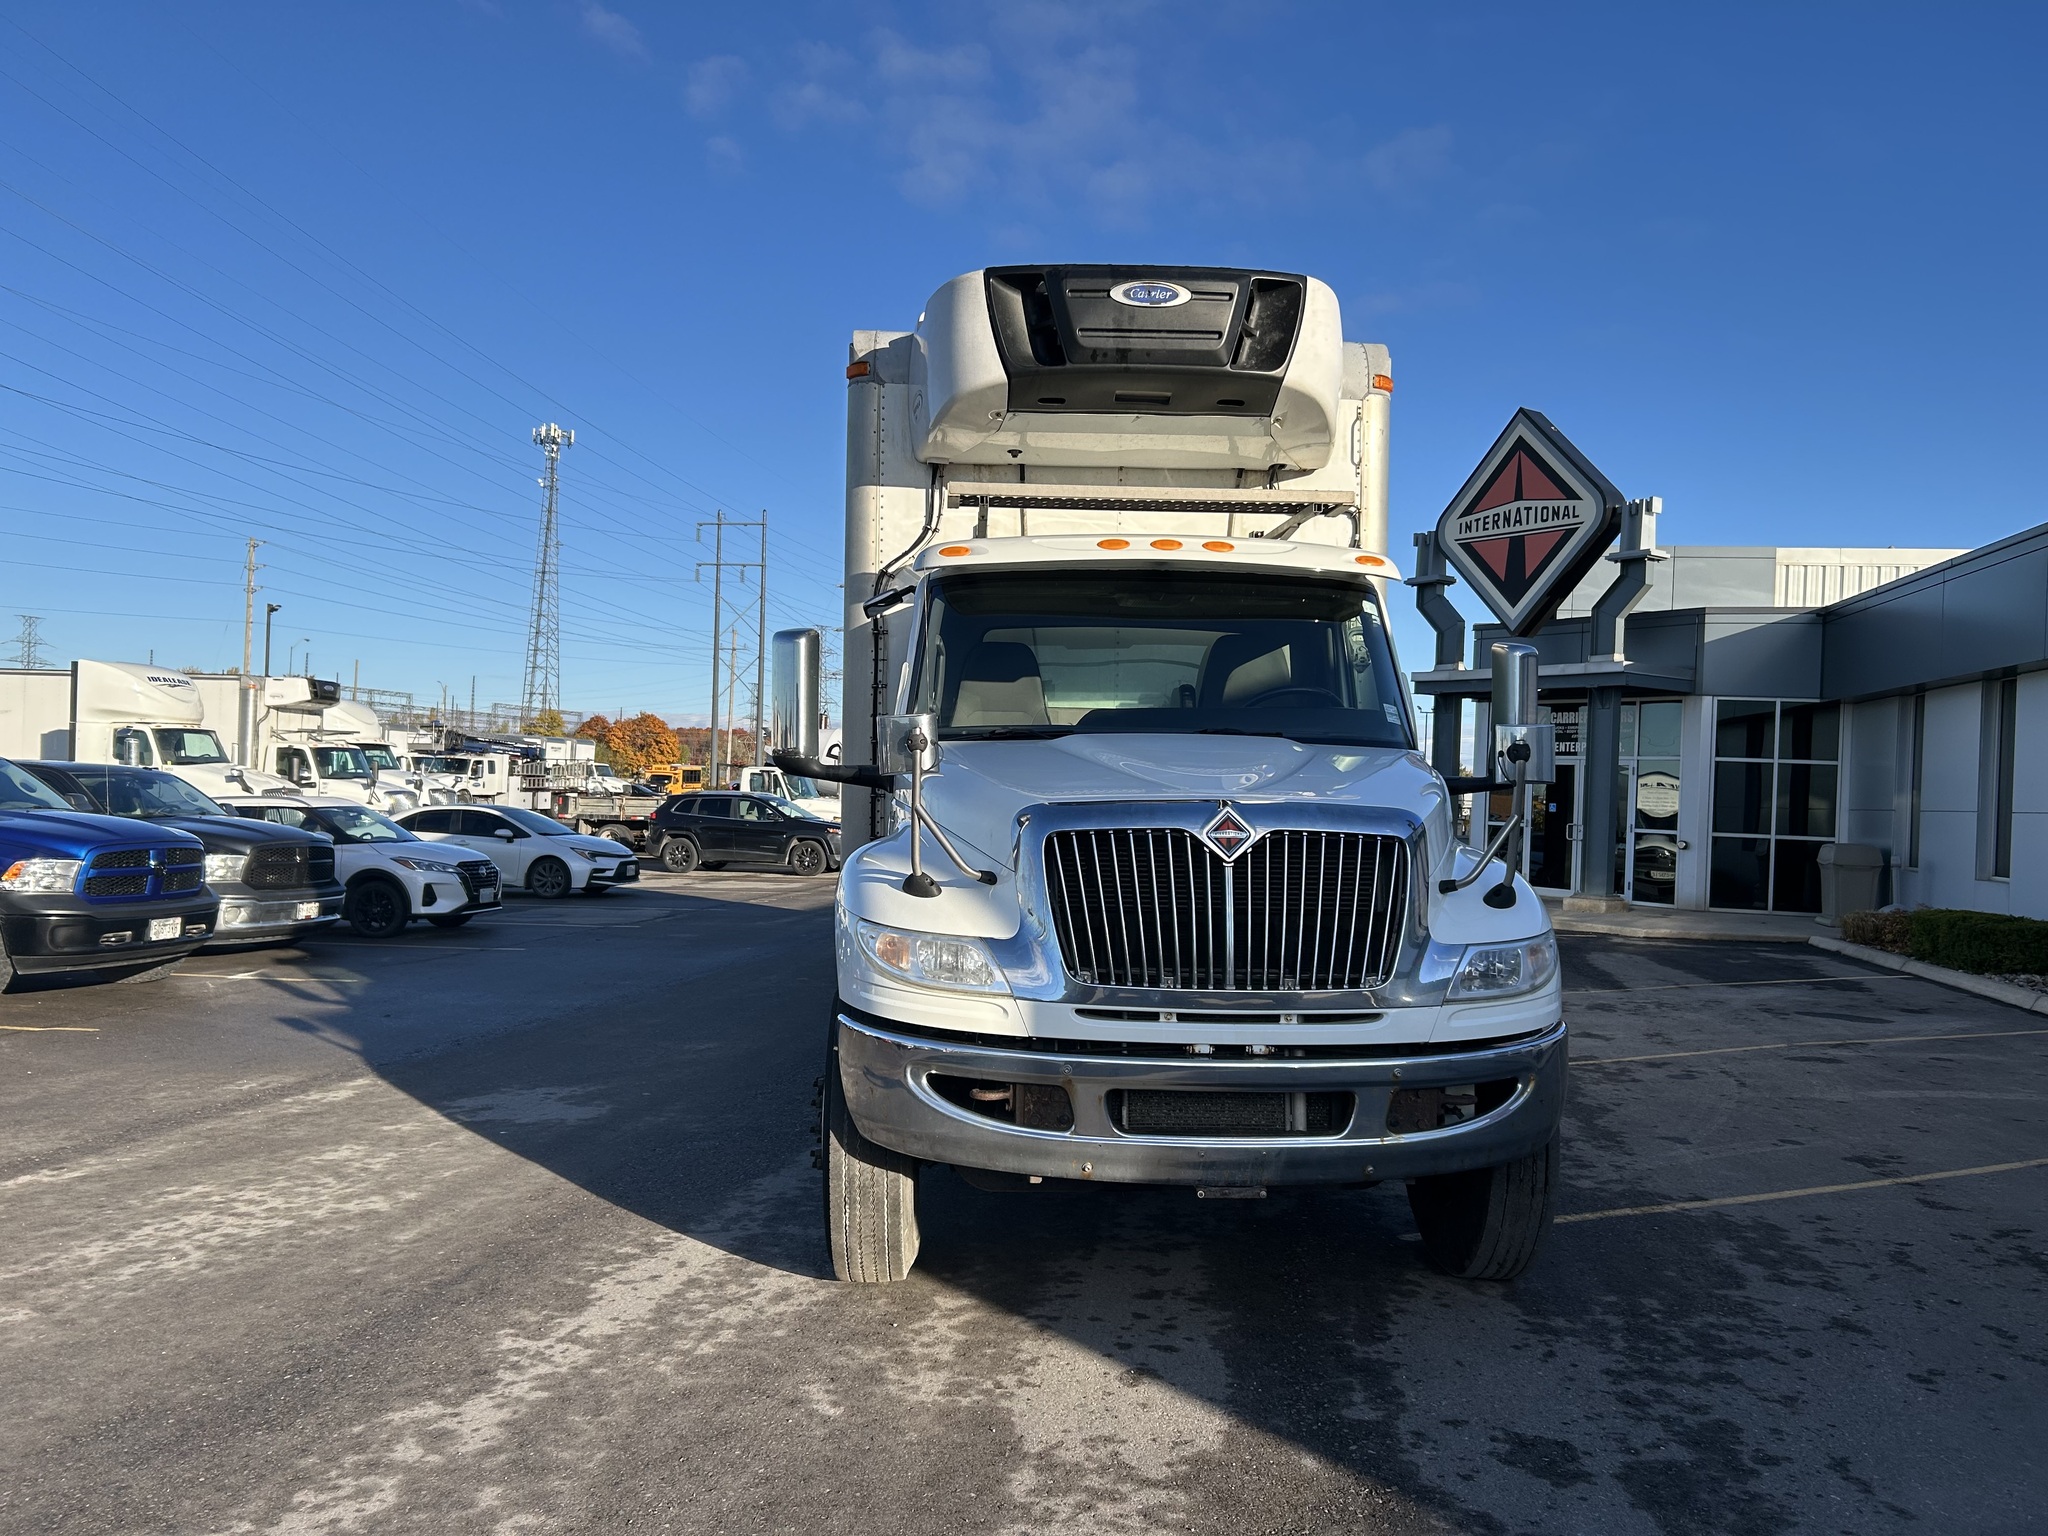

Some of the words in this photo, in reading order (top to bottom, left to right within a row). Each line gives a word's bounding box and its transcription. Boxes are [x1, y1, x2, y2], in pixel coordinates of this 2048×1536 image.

[1130, 288, 1173, 299] Carrier
[1458, 504, 1580, 535] INTERNATIONAL
[146, 676, 192, 686] IDEALEASE
[1555, 741, 1587, 752] ENTERP
